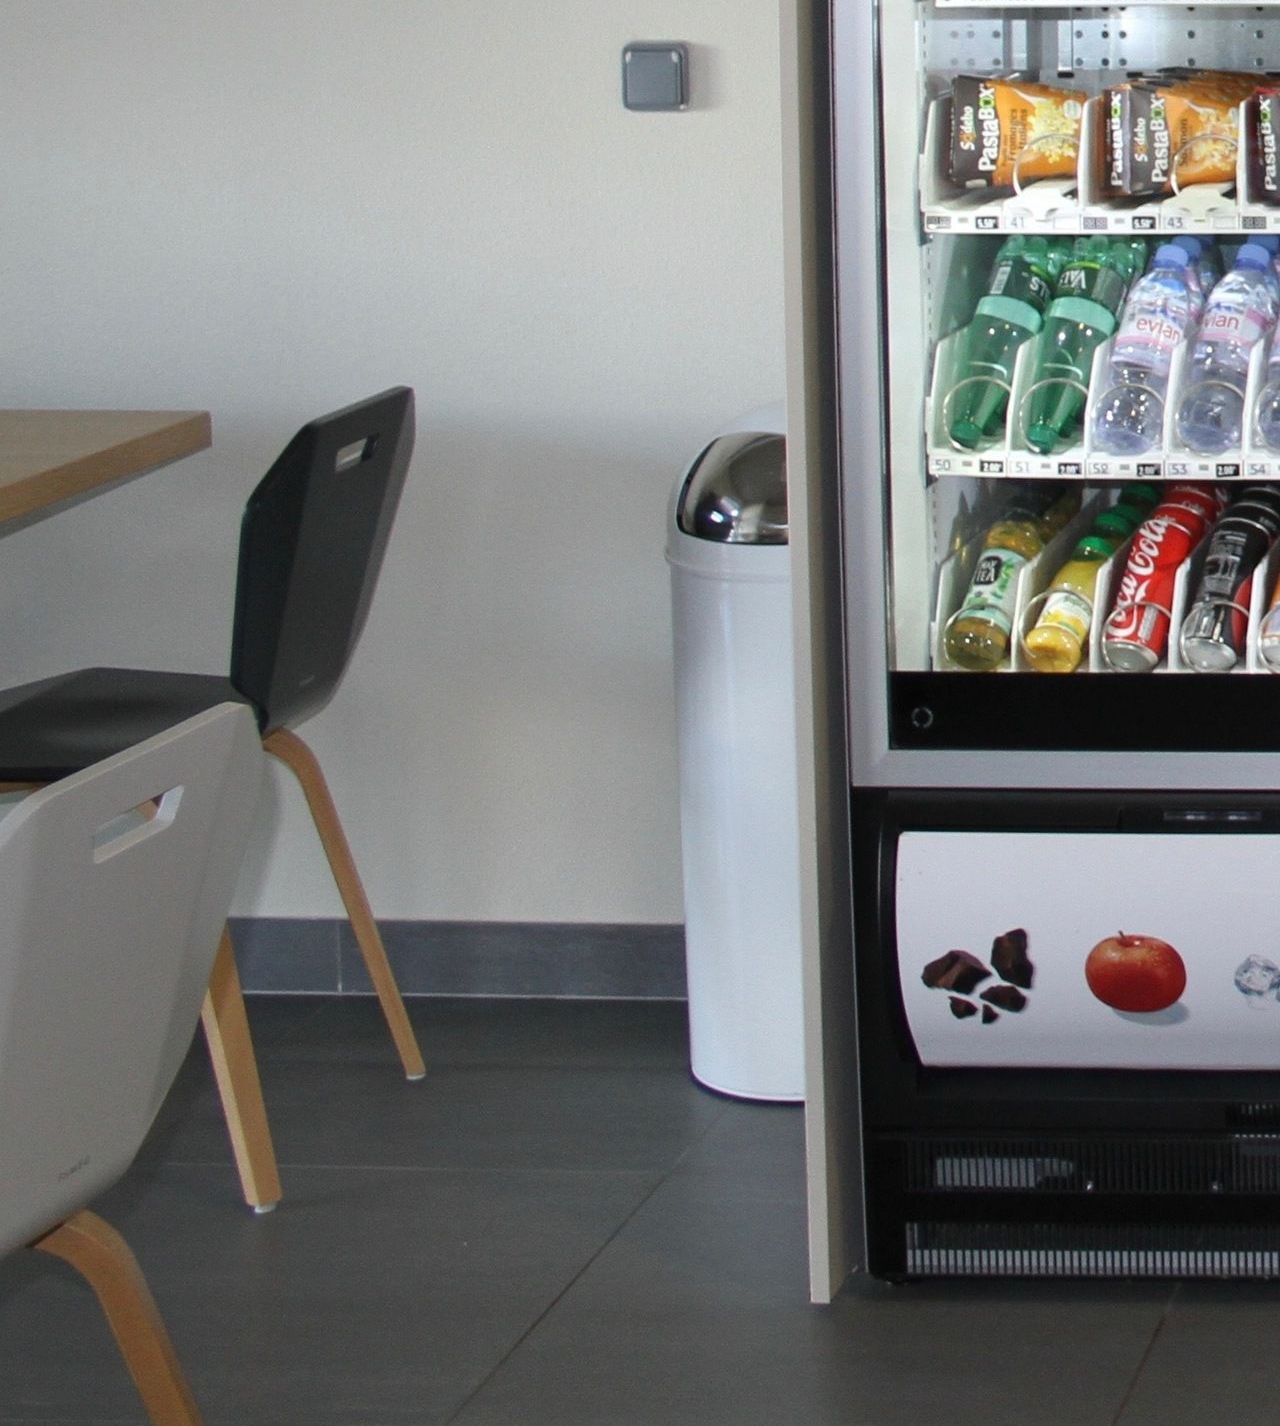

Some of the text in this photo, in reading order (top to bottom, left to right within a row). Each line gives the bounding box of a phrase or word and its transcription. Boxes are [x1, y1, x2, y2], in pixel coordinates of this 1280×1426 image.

[1010, 218, 1025, 229] 41
[1167, 217, 1184, 229] 43
[1202, 312, 1241, 329] vian
[1136, 319, 1182, 343] evian
[935, 459, 951, 472] 50
[1015, 462, 1030, 473] 51
[1092, 463, 1108, 474] 52
[1171, 463, 1187, 474] 53
[1250, 463, 1265, 474] 54
